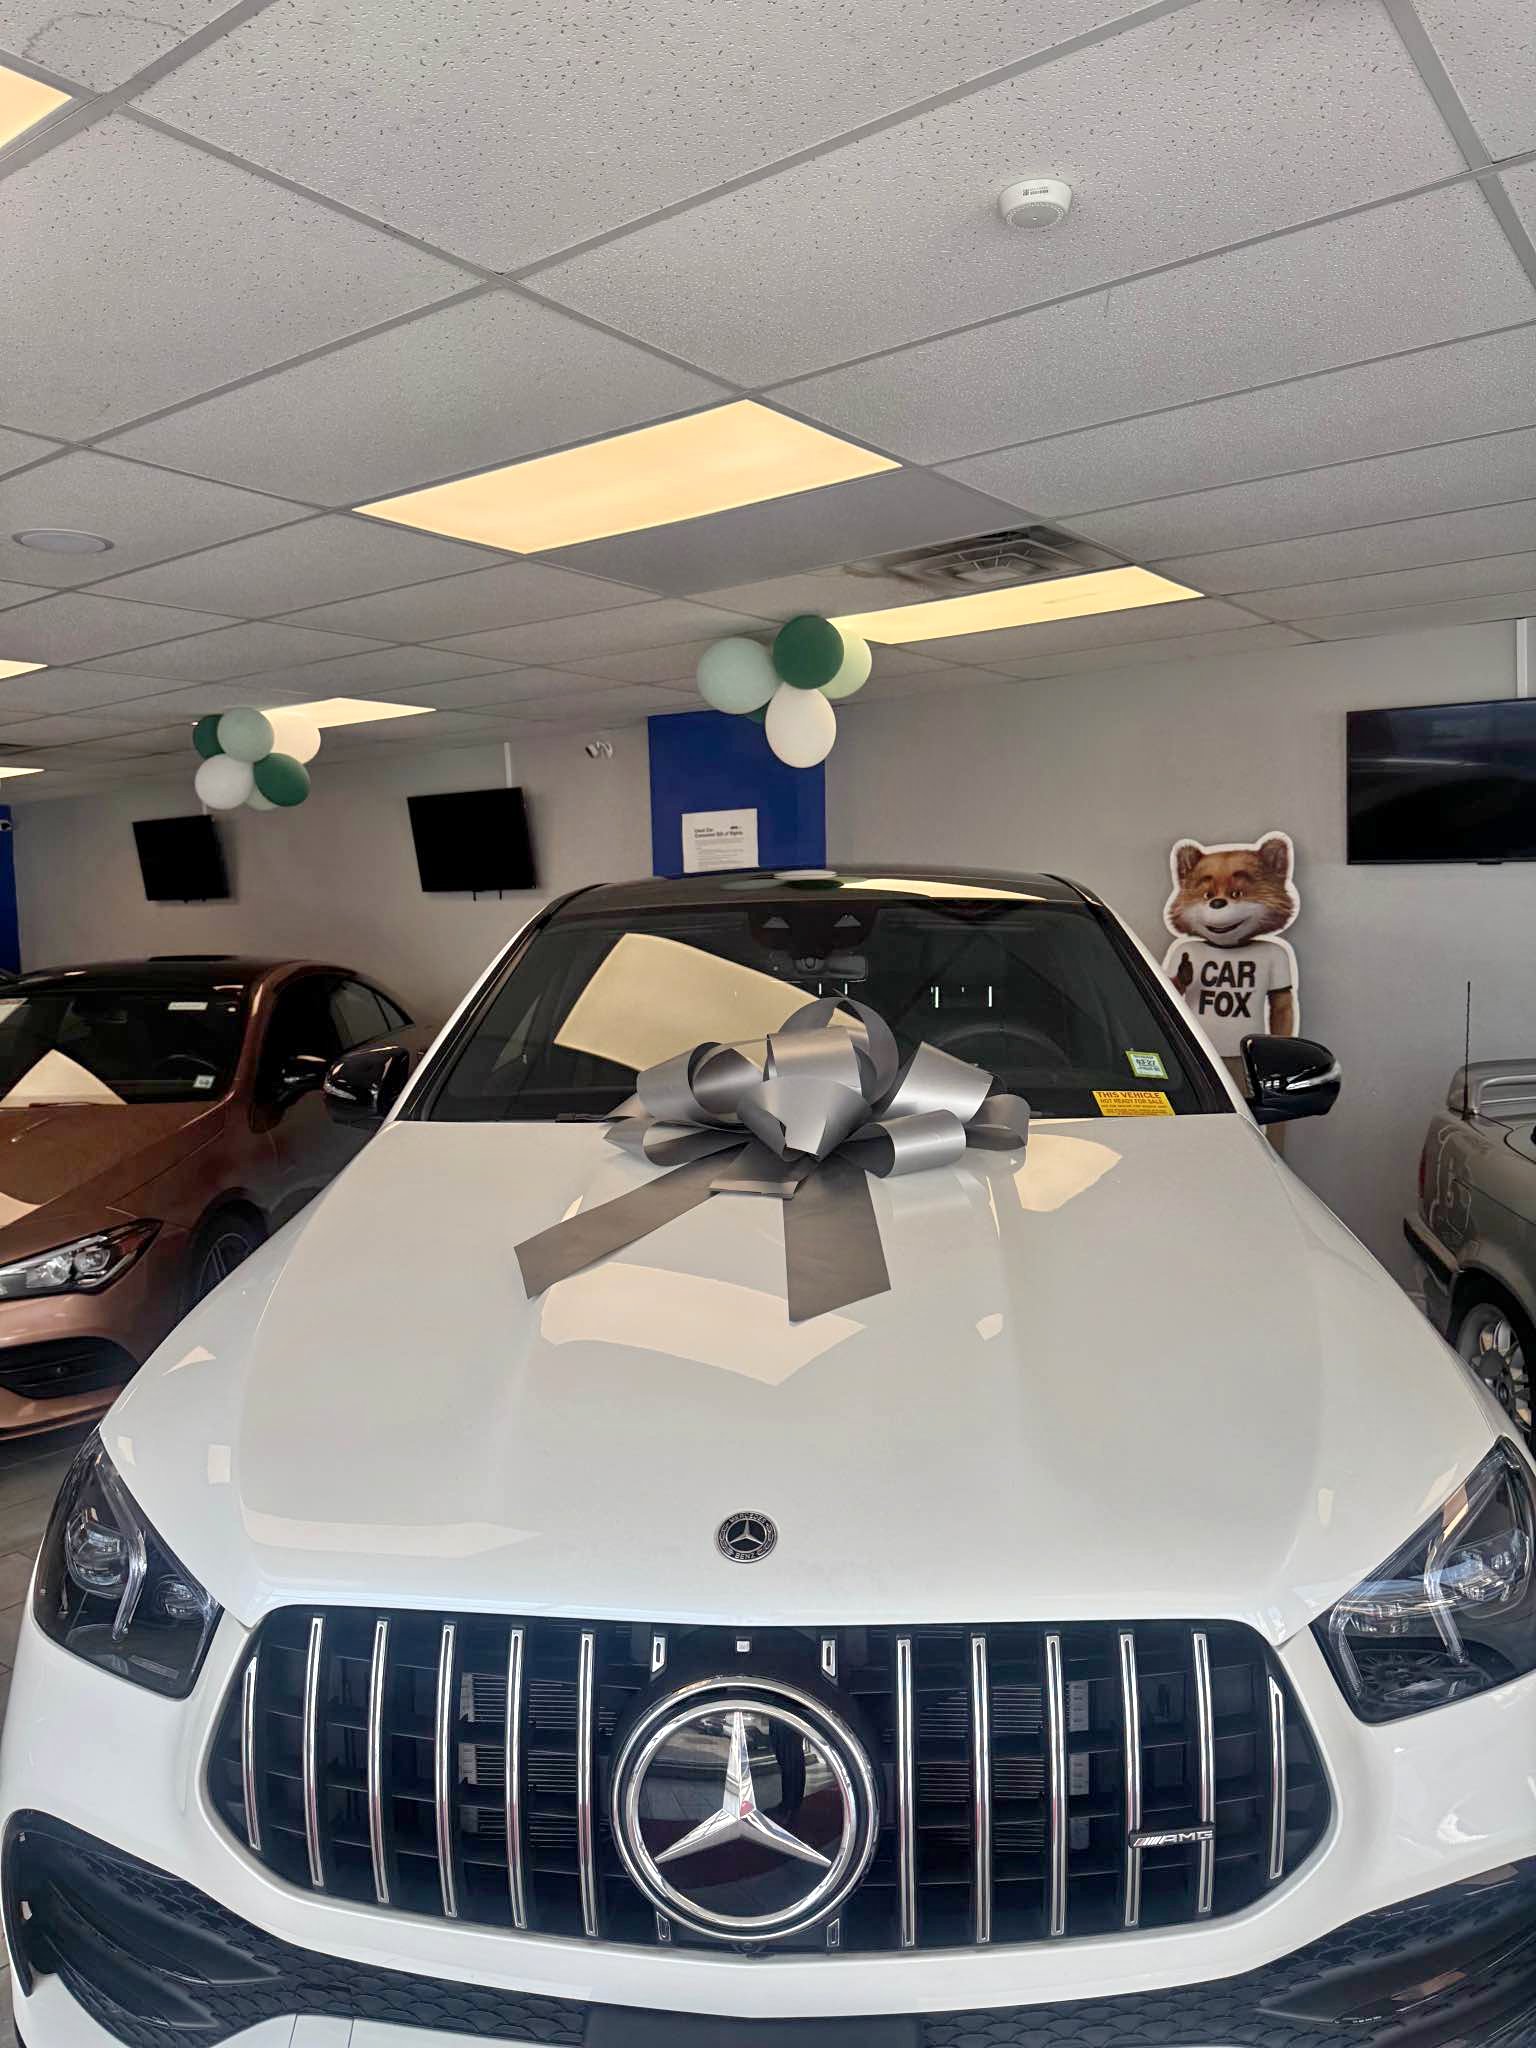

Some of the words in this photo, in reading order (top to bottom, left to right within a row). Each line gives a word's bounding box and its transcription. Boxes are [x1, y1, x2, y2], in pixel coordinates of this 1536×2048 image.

[1200, 960, 1256, 988] CAR
[1199, 989, 1252, 1018] FOX
[1097, 1091, 1119, 1099] THIS
[1119, 1091, 1161, 1099] VEHICLE
[734, 1552, 757, 1560] BENZ
[1159, 1830, 1213, 1845] AMG
